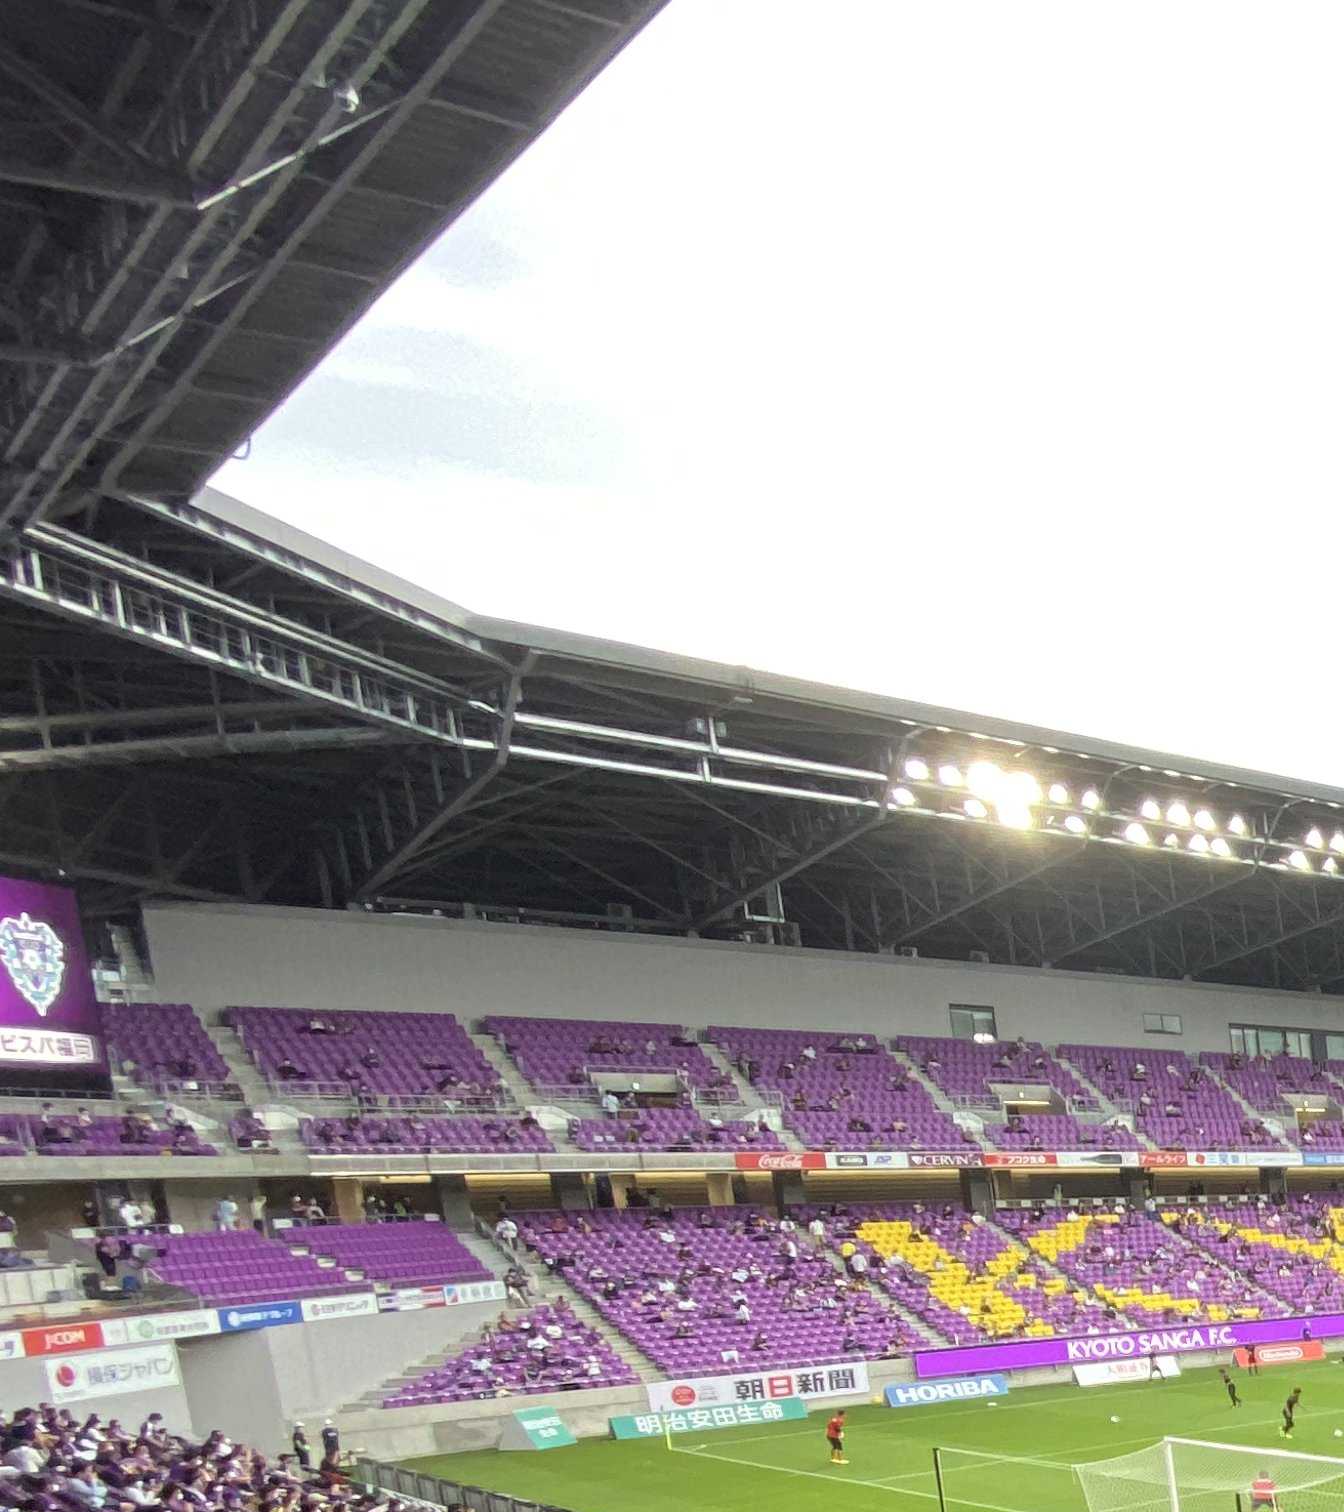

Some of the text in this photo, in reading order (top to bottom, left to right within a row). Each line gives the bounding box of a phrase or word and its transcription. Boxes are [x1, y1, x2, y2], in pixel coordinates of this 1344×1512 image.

[1066, 1328, 1238, 1361] KYOTO SANGA F.C.
[735, 1369, 857, 1401] 朝日新聞
[895, 1379, 1000, 1404] HORIBA
[634, 1402, 785, 1436] 明治安田生命
